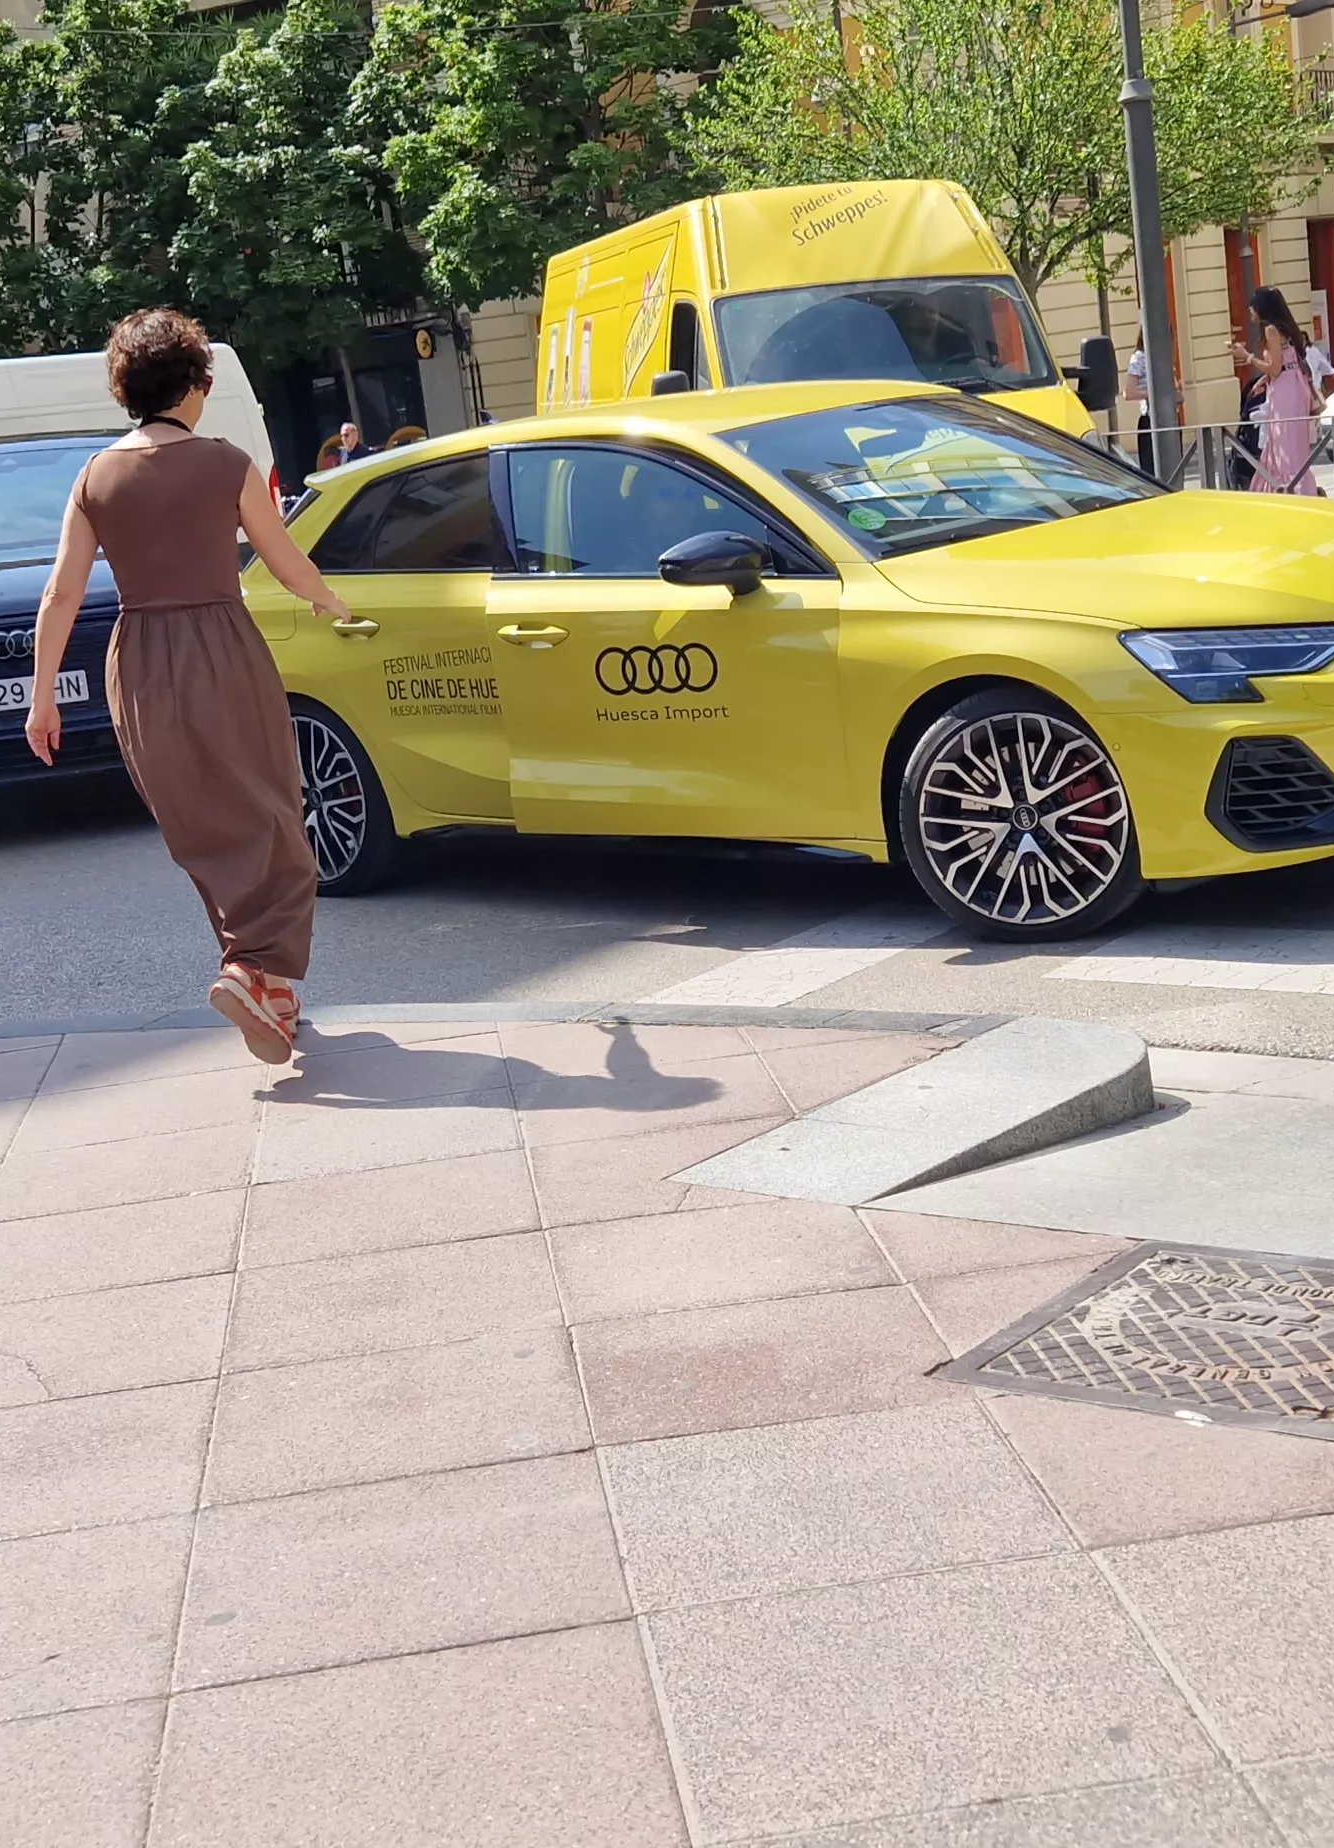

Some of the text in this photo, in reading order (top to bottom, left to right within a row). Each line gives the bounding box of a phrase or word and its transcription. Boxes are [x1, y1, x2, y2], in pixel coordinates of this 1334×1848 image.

[837, 186, 853, 197] tu
[791, 189, 888, 247] Schweppes!
[383, 645, 492, 676] FESTIVAL INTERNACI
[386, 678, 500, 701] DE CINE DE HUE
[390, 704, 421, 717] HUESCA
[422, 703, 479, 716] INTERNATIONAL
[480, 703, 498, 716] FILM
[595, 705, 730, 722] Huesca Import
[1154, 1270, 1257, 1291] TRAFICO
[1258, 1282, 1287, 1296] DE
[1182, 1306, 1281, 1328] DGT
[1128, 1356, 1272, 1382] GENERAL
